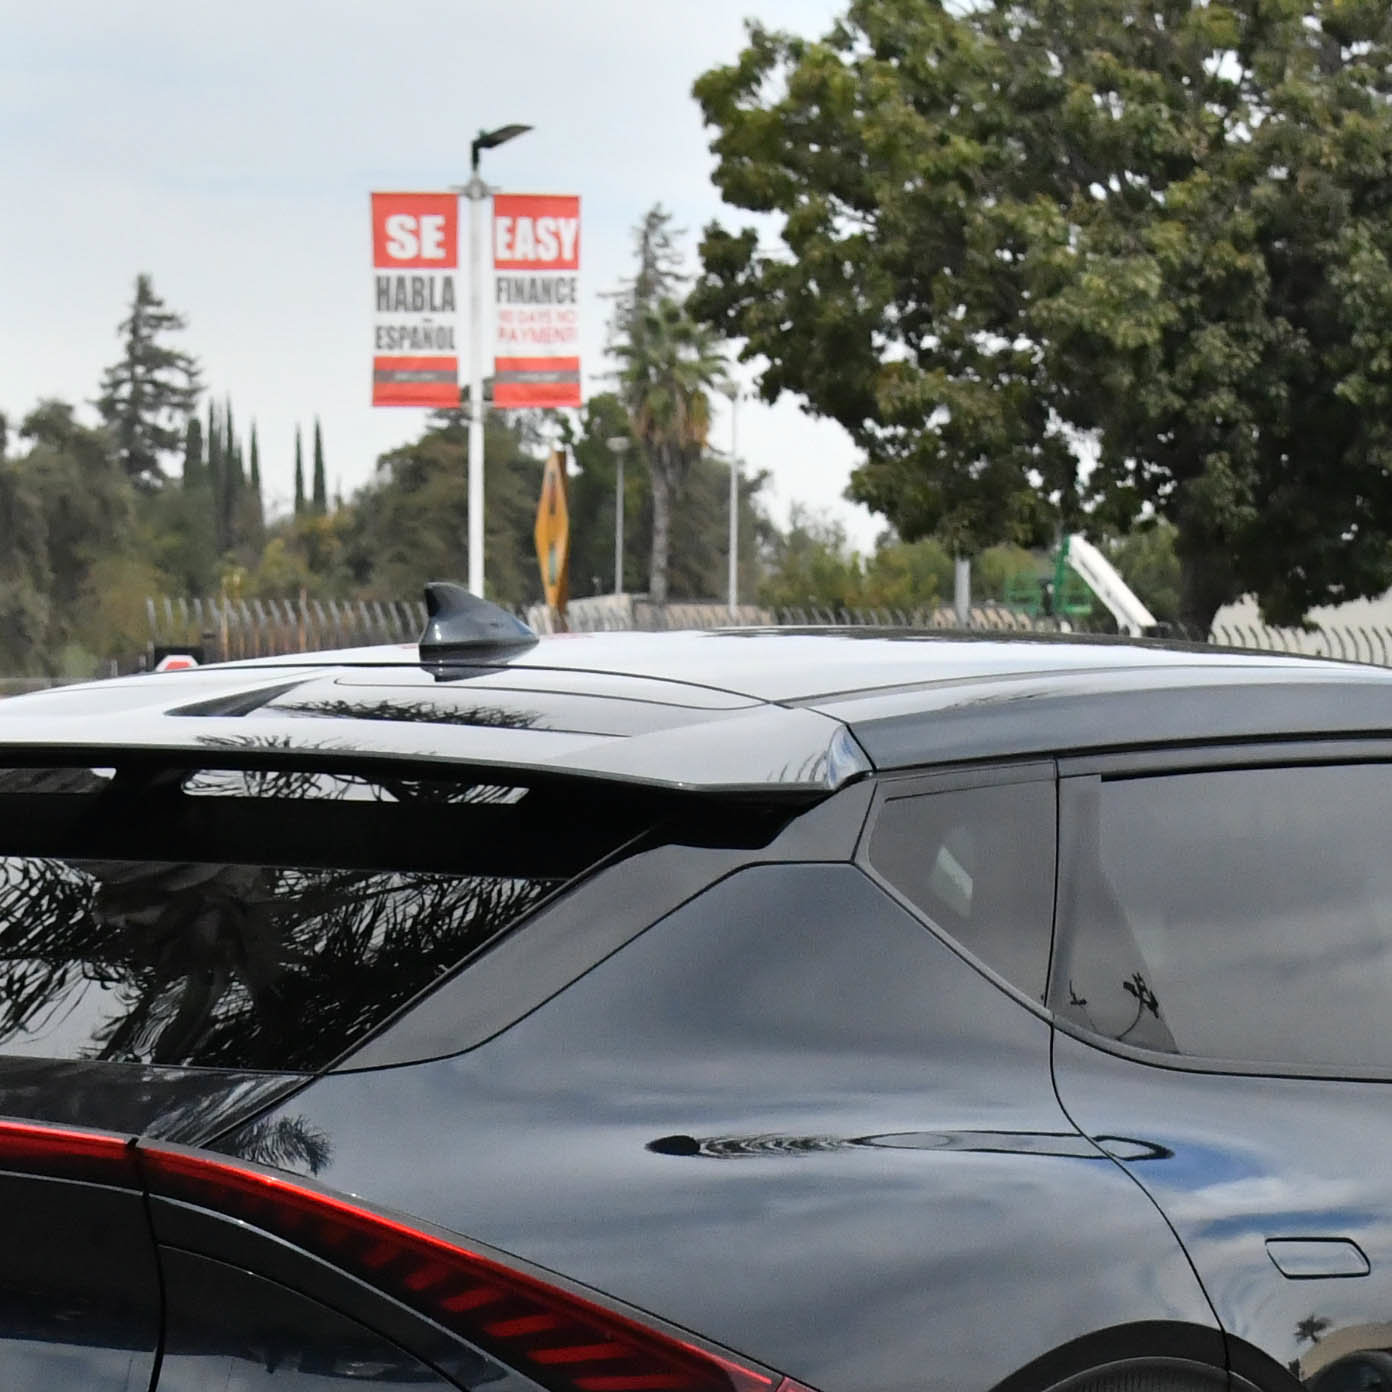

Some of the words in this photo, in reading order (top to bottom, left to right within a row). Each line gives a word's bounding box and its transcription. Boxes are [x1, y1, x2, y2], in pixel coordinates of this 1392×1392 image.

[385, 213, 446, 260] SE
[495, 216, 577, 262] EASY
[375, 275, 456, 312] HABLA
[496, 276, 577, 304] FINANCE
[375, 318, 456, 350] ESPAÑOL
